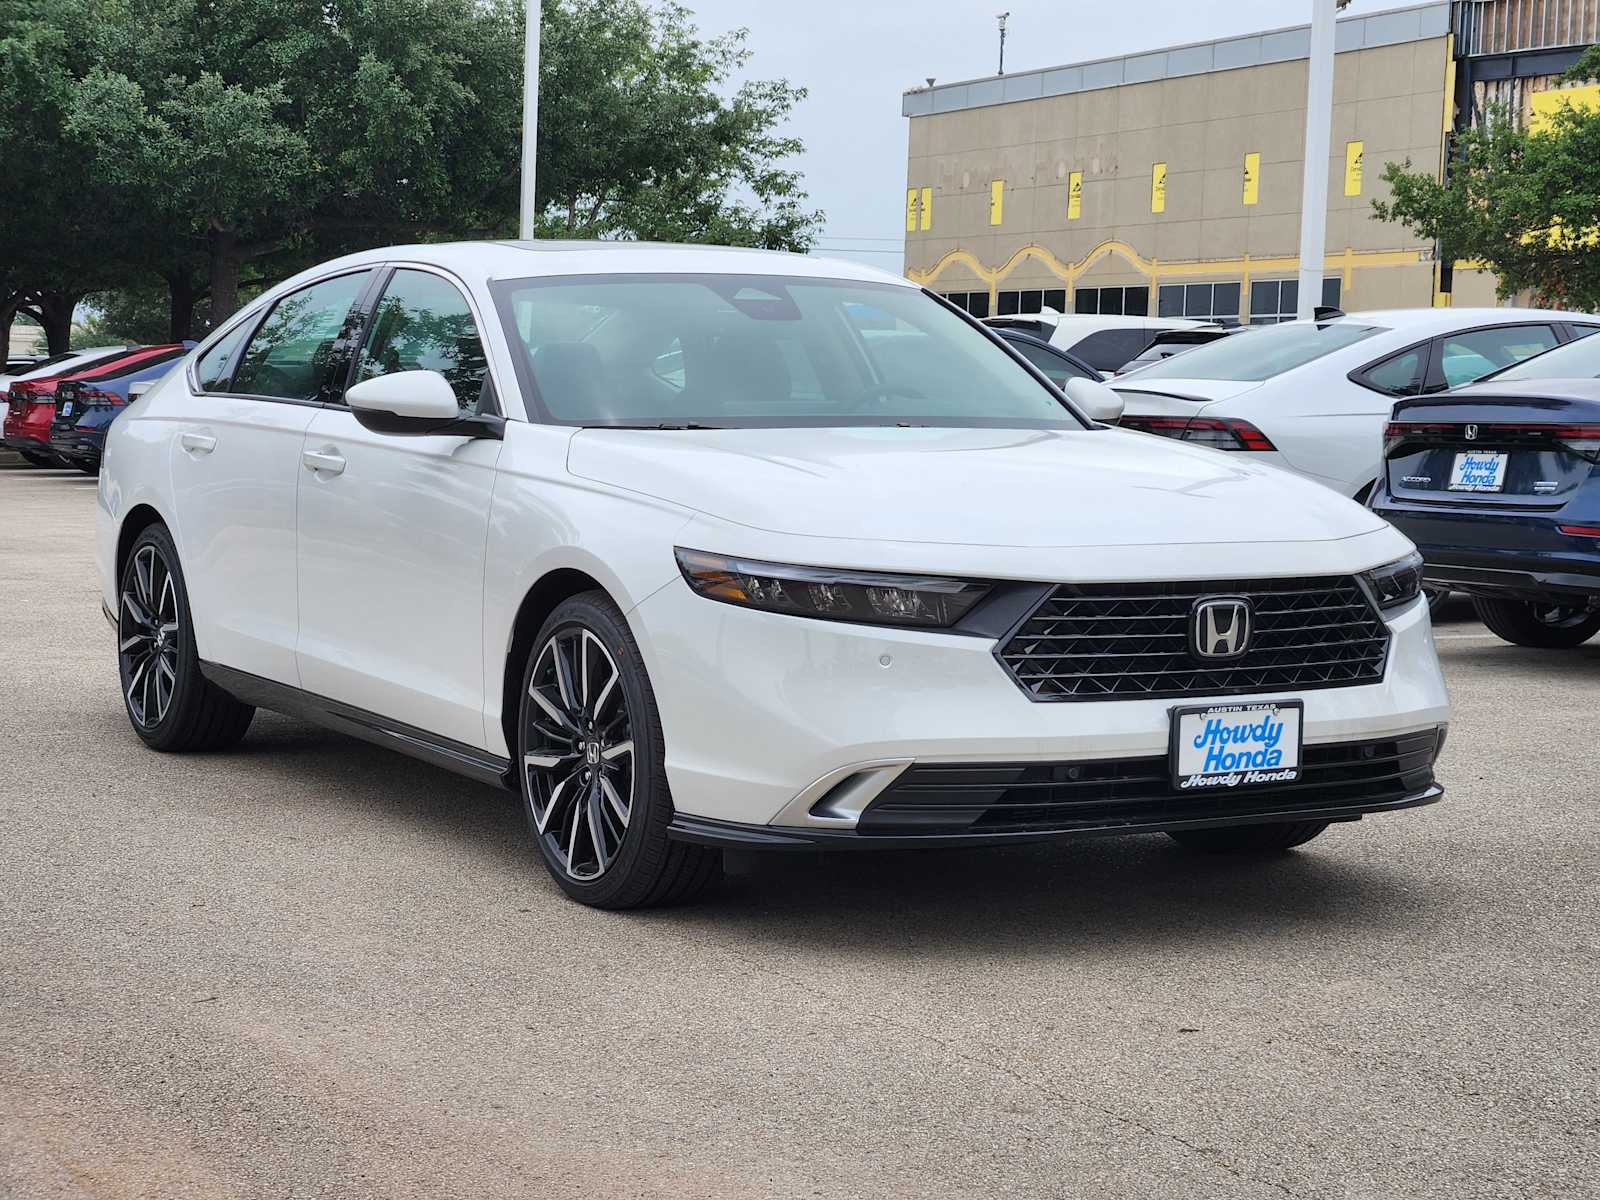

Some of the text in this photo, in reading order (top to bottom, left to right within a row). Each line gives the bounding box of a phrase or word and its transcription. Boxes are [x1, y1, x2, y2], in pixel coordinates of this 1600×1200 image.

[1460, 457, 1499, 472] Howdy
[1461, 470, 1496, 484] Honda
[1207, 703, 1276, 714] AUSTIN TEXAS
[1193, 715, 1284, 749] Howdy
[1202, 746, 1283, 772] Honda
[1180, 769, 1297, 789] Howdy Honda
